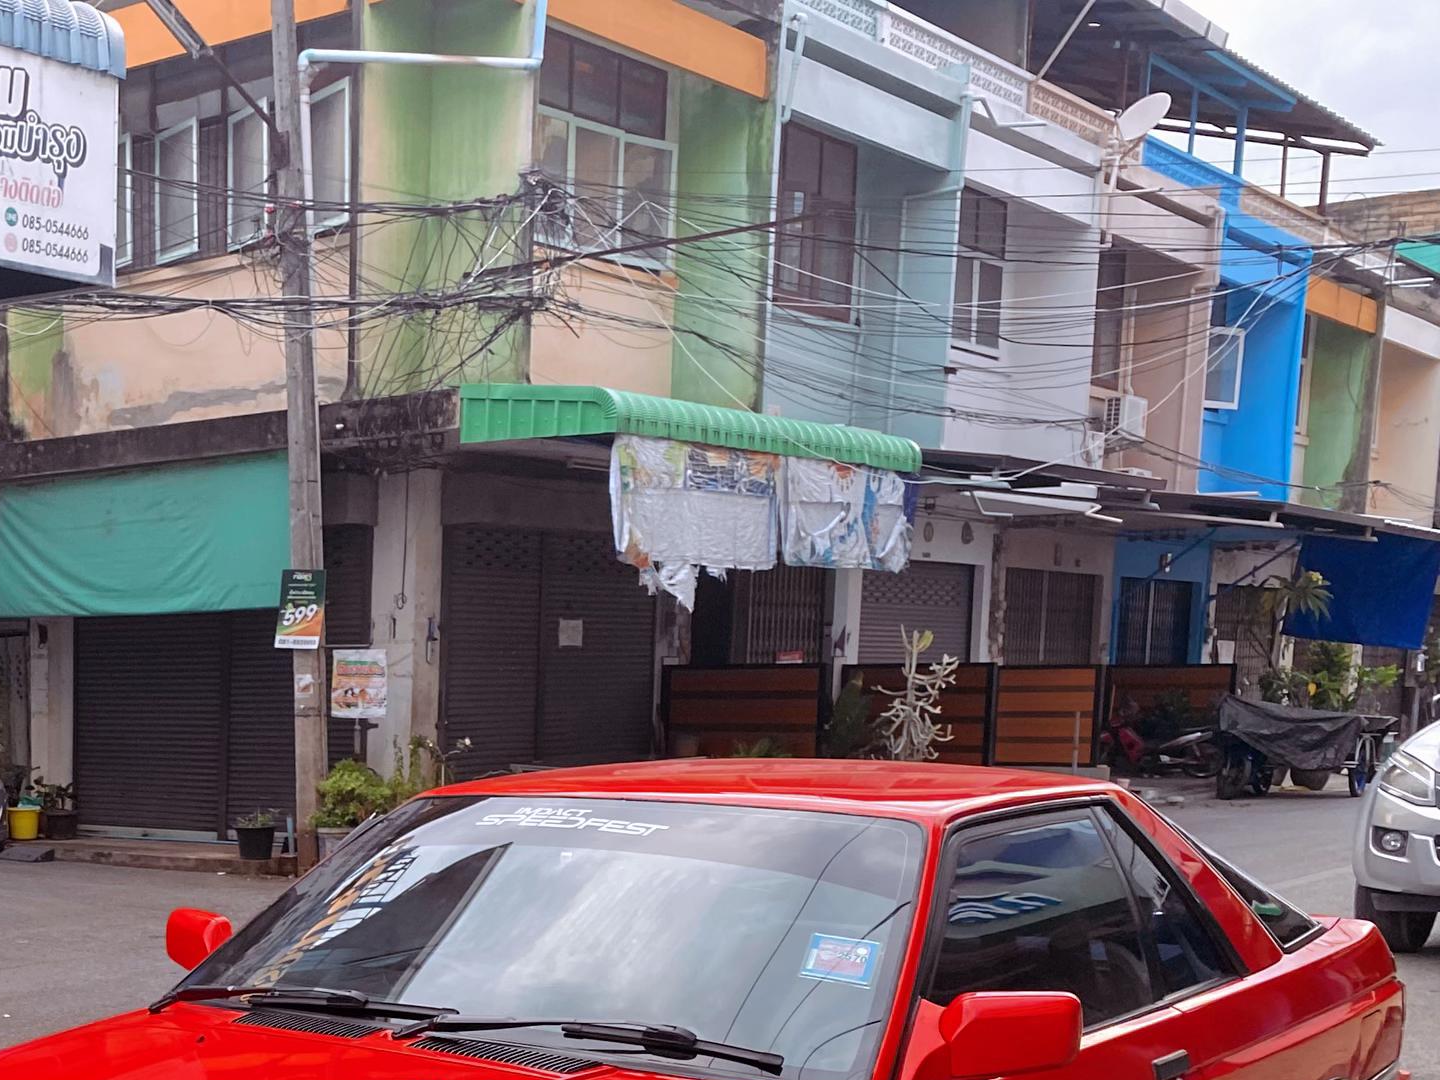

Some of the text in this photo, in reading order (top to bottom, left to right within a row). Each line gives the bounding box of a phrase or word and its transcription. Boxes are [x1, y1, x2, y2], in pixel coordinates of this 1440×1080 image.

[22, 214, 89, 240] 085-0544666
[21, 237, 89, 264] 085-0544666
[281, 603, 318, 626] 599
[513, 806, 593, 816] IMPACT
[474, 814, 671, 837] SPEEDFEST
